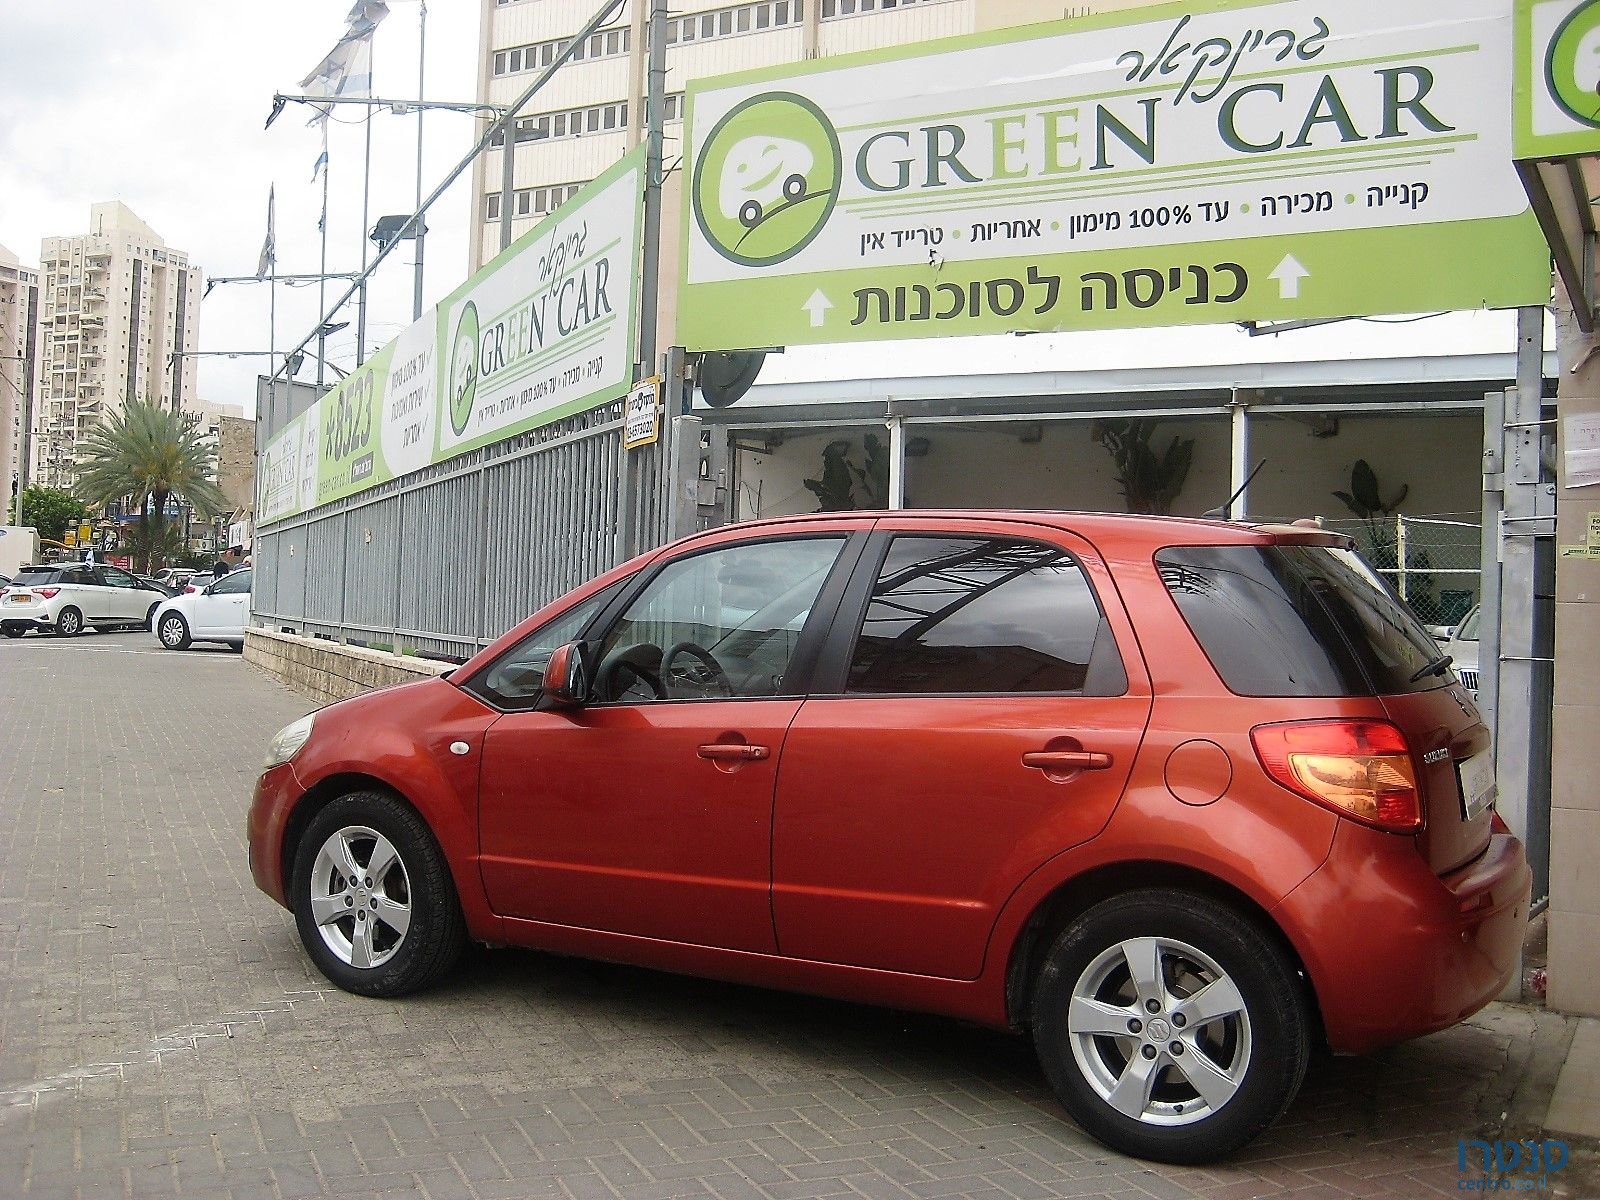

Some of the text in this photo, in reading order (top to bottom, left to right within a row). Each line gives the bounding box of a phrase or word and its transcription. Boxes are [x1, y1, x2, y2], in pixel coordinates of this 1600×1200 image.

[1115, 14, 1330, 107] גרינקאר
[855, 65, 1456, 192] GREEN CAR
[860, 181, 1429, 256] קנייה מכירה עד 100% מימון אחריות טרייד אין
[481, 257, 612, 377] GREEN CAR
[850, 262, 1249, 326] כניסה לסוכנות
